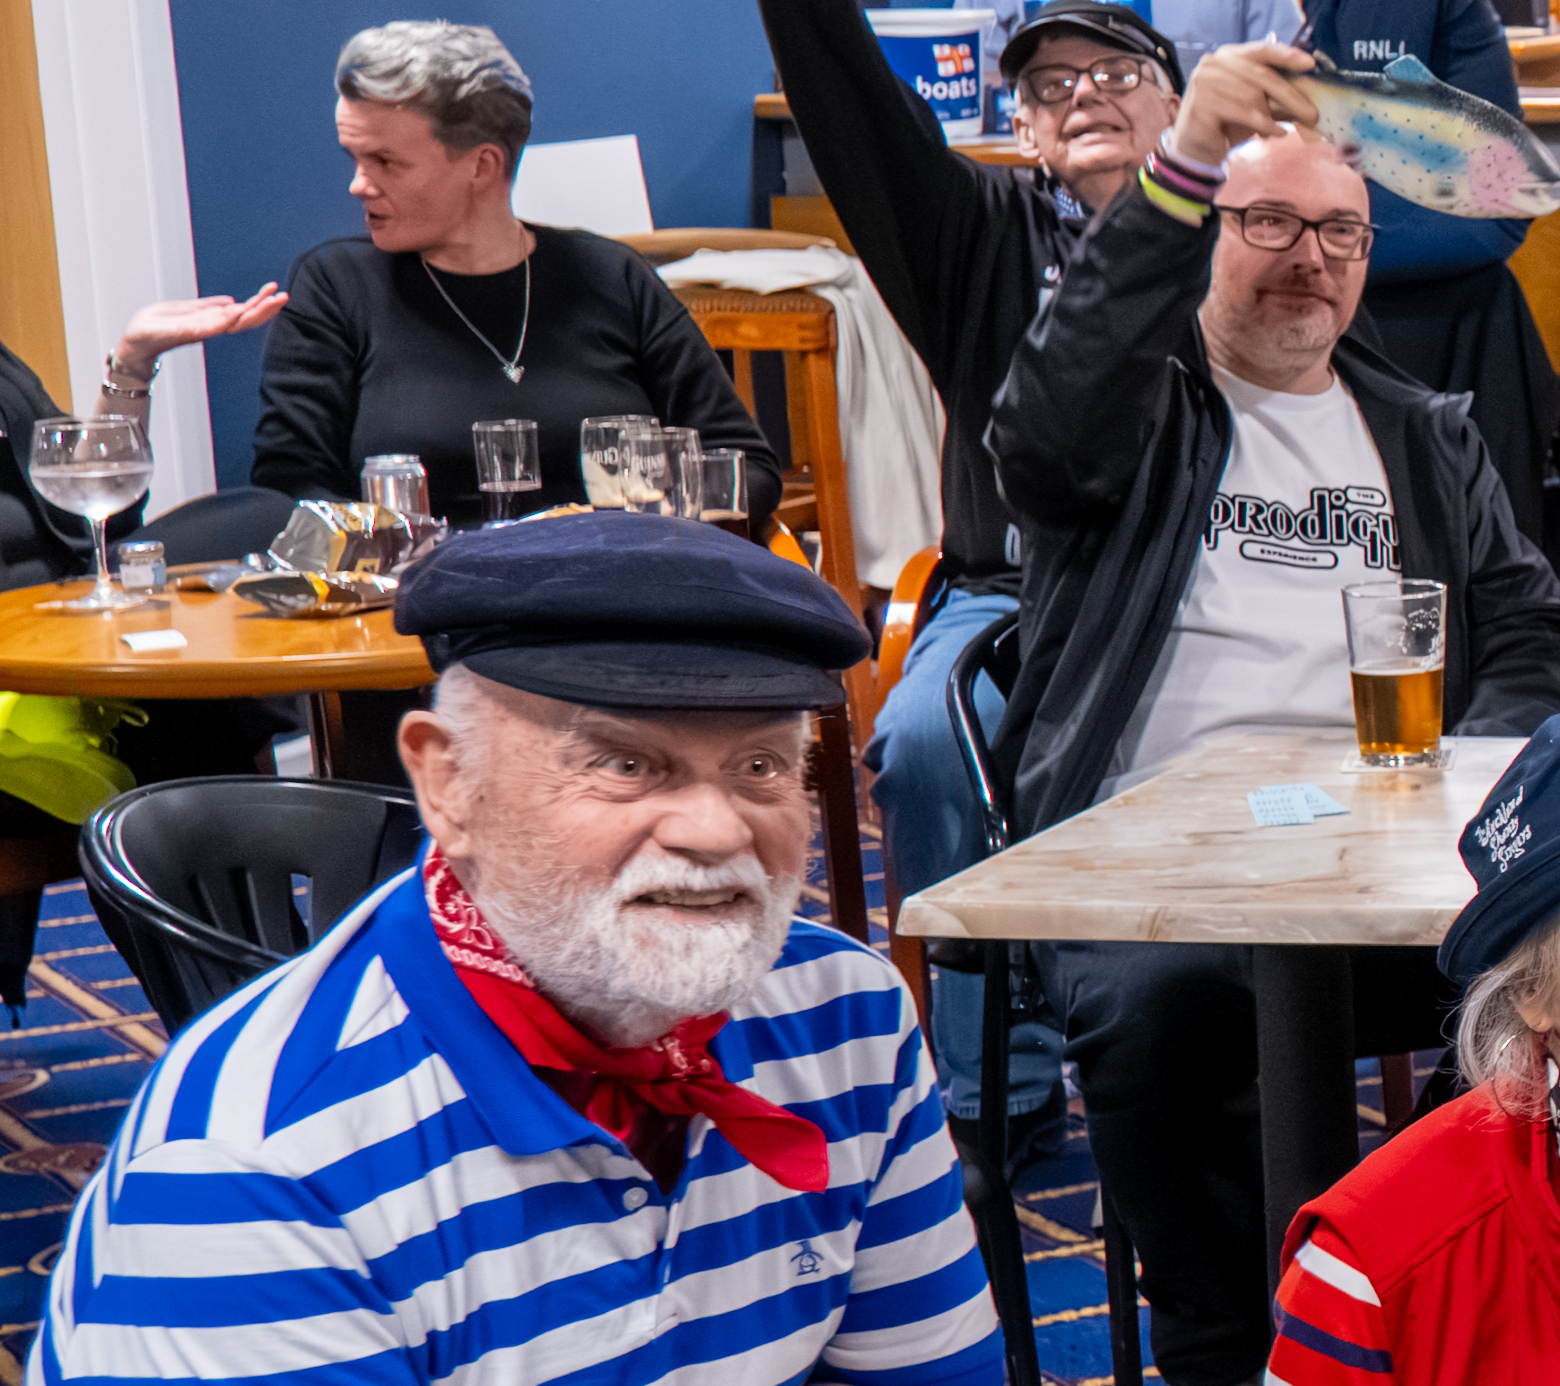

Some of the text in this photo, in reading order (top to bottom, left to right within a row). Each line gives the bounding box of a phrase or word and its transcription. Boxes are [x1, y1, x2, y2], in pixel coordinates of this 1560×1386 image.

[1353, 39, 1406, 61] RNLI
[914, 75, 978, 101] boats
[1498, 823, 1533, 874] Singers
